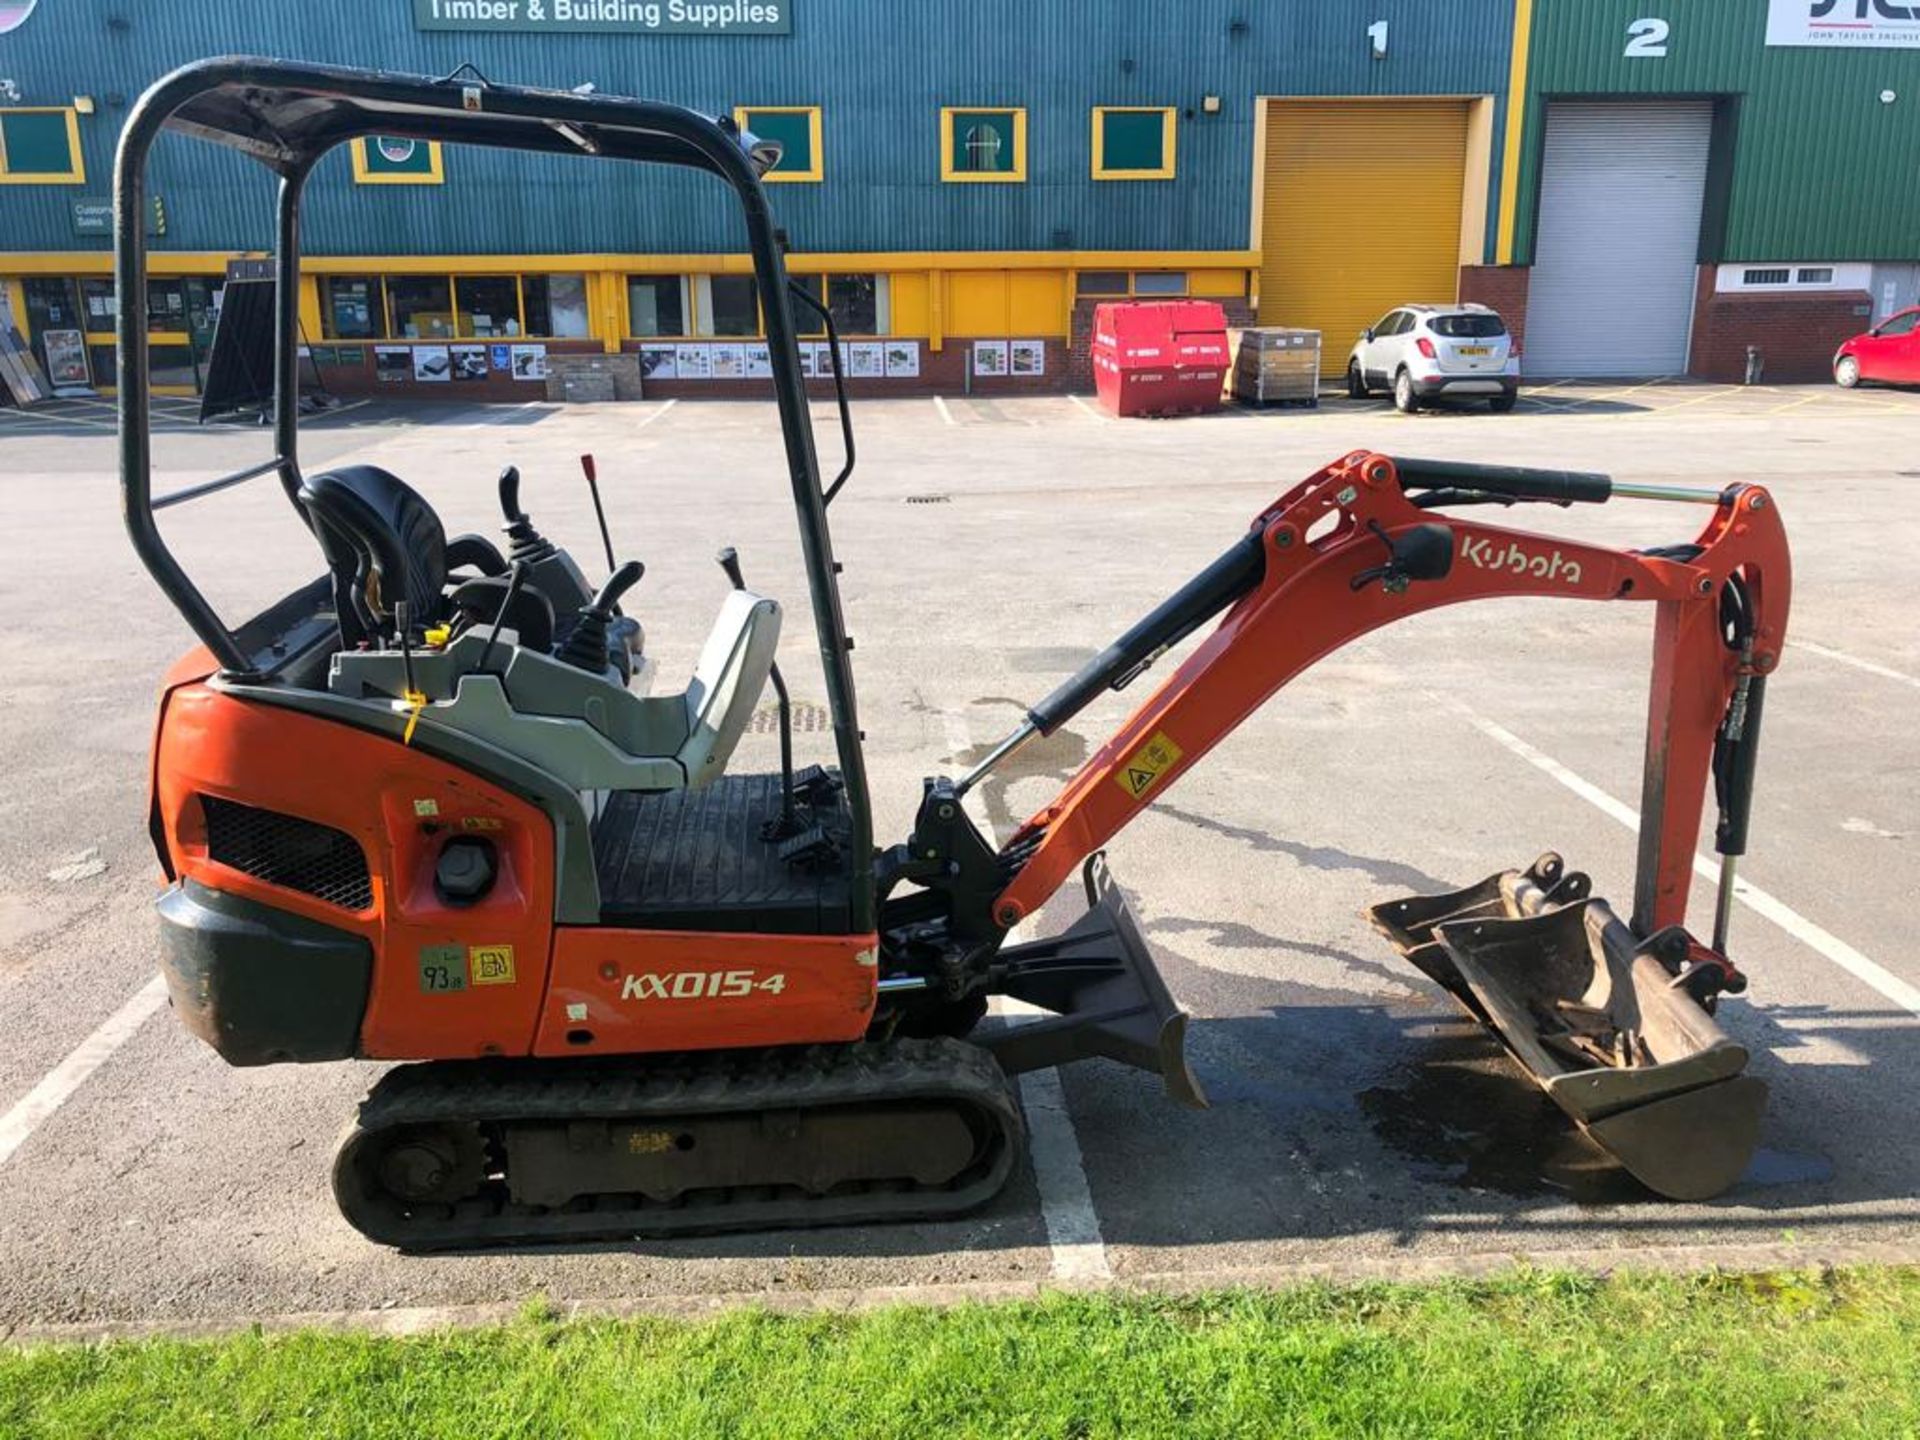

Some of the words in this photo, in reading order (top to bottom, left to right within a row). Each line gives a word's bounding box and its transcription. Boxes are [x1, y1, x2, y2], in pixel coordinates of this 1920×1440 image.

[432, 0, 518, 20] Timber
[527, 0, 546, 21] &
[554, 0, 661, 28] Building
[668, 0, 779, 28] Supplies
[1368, 20, 1388, 59] 1
[1624, 18, 1670, 57] 2
[1461, 534, 1582, 584] Kubota
[423, 966, 449, 991] 93
